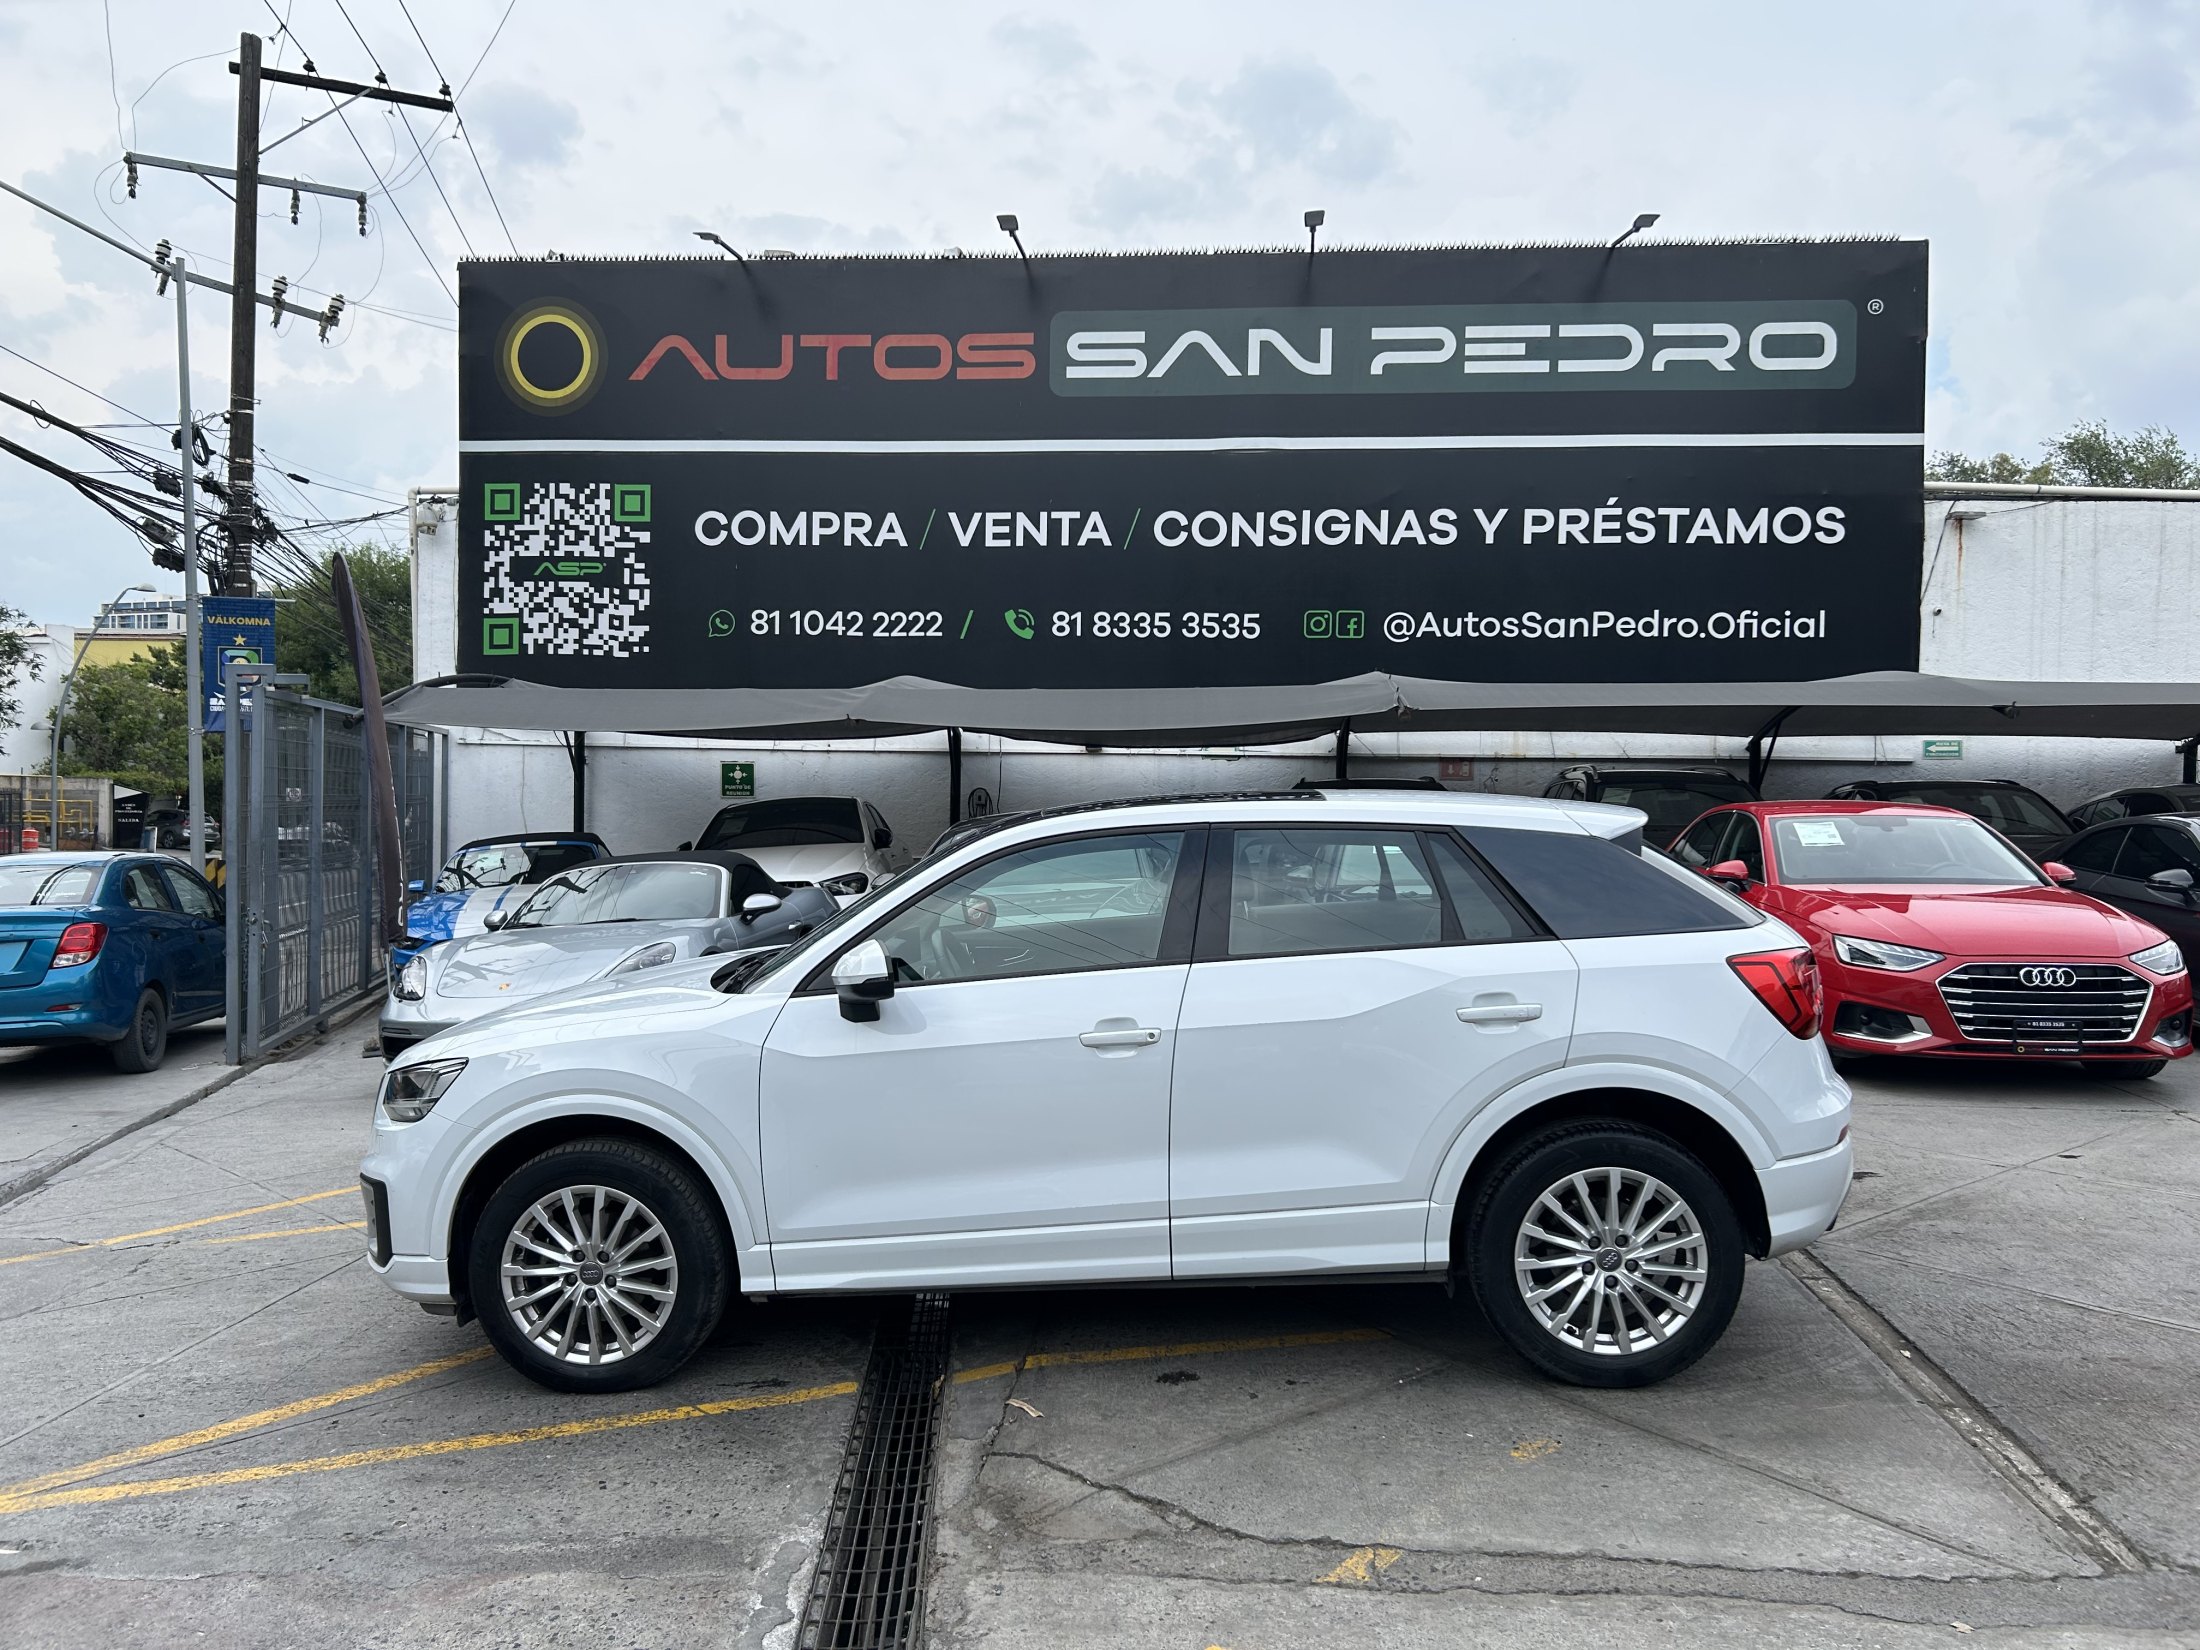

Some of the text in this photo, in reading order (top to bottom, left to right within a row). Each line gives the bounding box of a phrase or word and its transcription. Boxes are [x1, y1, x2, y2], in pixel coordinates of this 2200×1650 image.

[629, 333, 1037, 381] AUTOS
[1065, 327, 1333, 380] SAN
[1369, 320, 1839, 376] PEDRO
[694, 509, 909, 547] COMPRA
[947, 511, 1113, 547] VENTA
[1153, 508, 1458, 548] CONSIGNAS
[1472, 508, 1509, 545] Y
[1523, 496, 1846, 545] PRÉSTAMOS
[207, 615, 271, 626] VÄLKOMNA
[750, 609, 780, 636] 81
[789, 609, 864, 637] 1042
[872, 611, 943, 638] 2222
[1051, 610, 1261, 640] 81 8335 3535
[1383, 608, 1826, 643] @AutosSanPedro.Oficial
